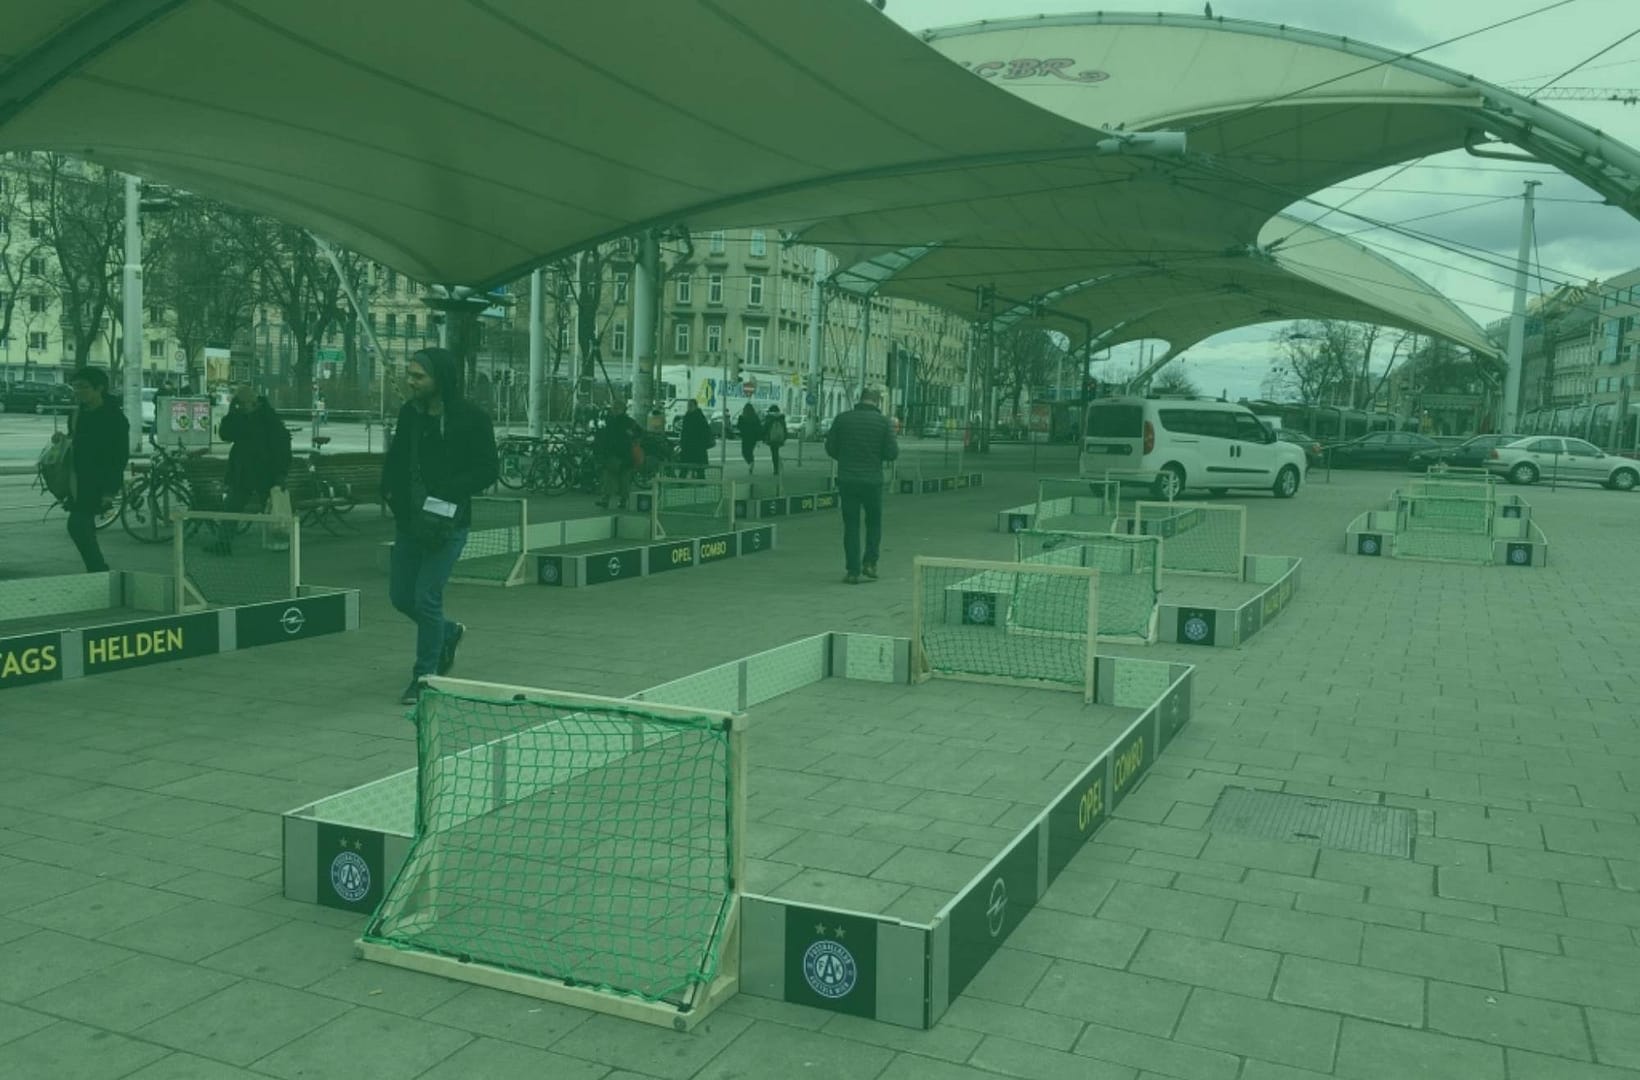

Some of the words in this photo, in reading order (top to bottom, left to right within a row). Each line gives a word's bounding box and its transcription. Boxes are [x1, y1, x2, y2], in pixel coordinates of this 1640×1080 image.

[672, 547, 692, 564] OPEL
[701, 541, 727, 558] COMBO
[0, 645, 57, 678] AGS
[88, 627, 184, 664] HELDEN
[1078, 778, 1103, 831] OPEL
[1113, 736, 1144, 792] COMBO
